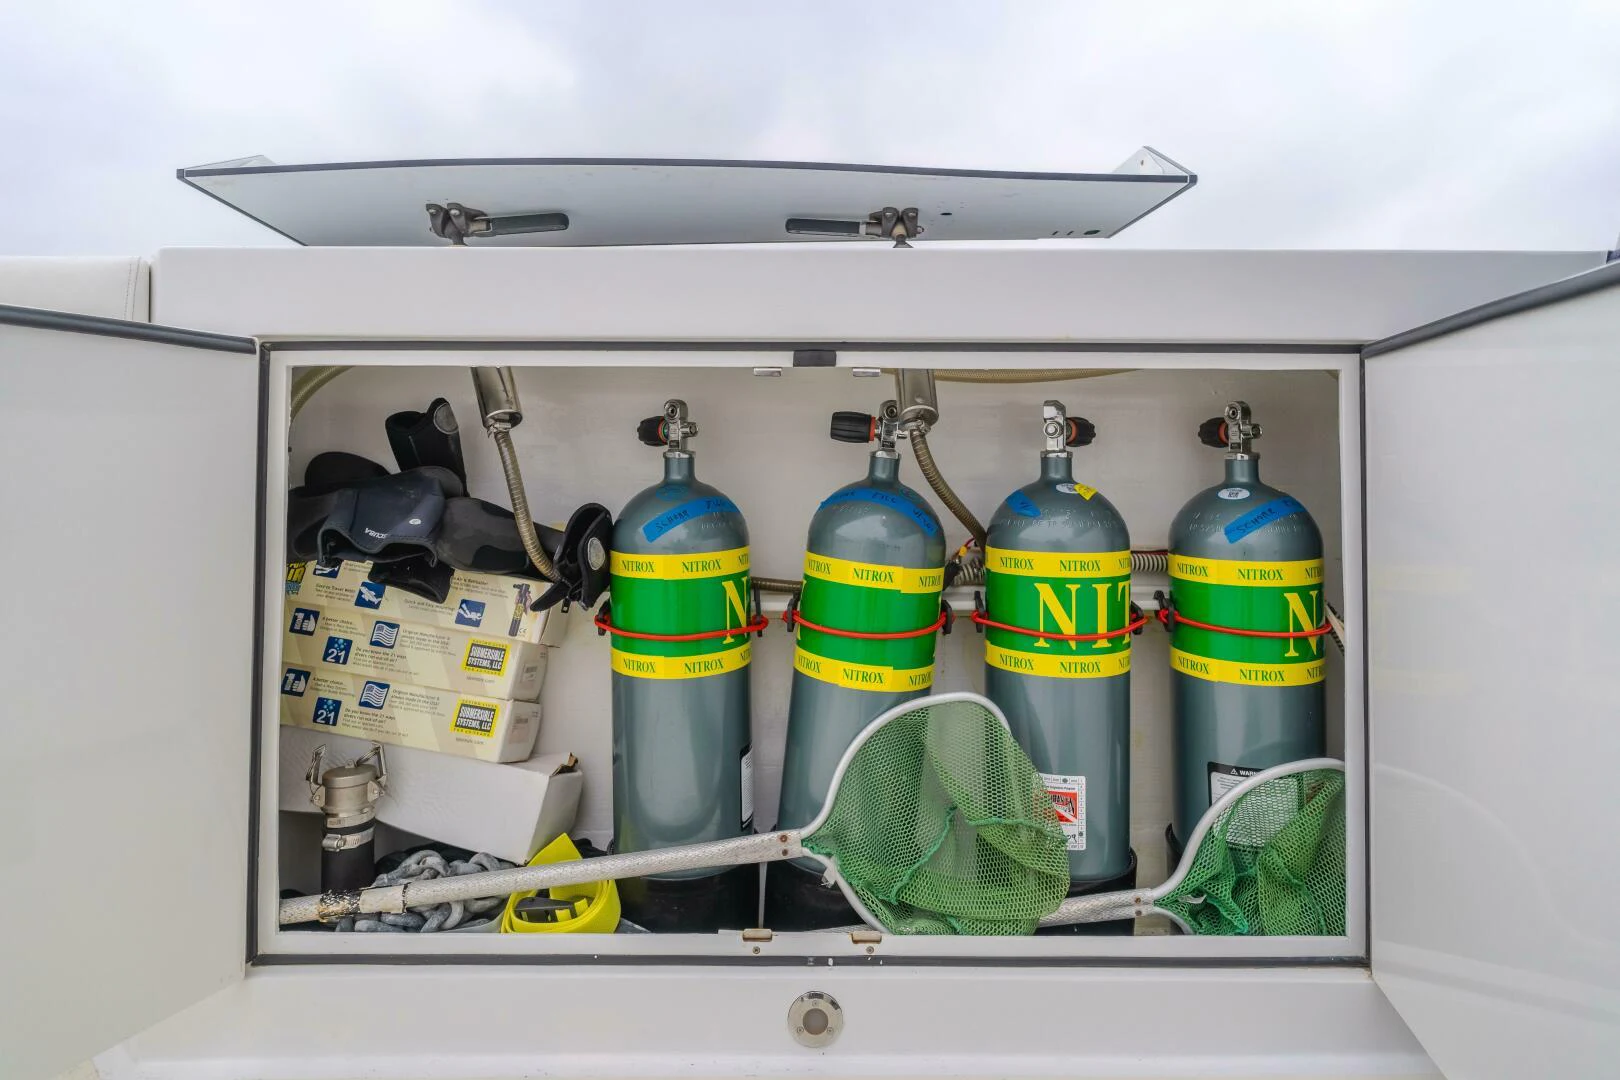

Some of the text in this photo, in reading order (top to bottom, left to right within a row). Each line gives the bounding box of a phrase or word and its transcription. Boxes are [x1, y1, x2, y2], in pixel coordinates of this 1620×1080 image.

[622, 560, 655, 573] NITROX
[682, 559, 721, 573] NITROX
[1000, 556, 1034, 570] NITROX
[1059, 559, 1101, 572] NITROX
[1177, 562, 1208, 577] NITROX
[1237, 568, 1284, 581] NITROX
[853, 567, 894, 583] NITROX
[326, 648, 346, 664] 21
[470, 646, 505, 661] SUBMERSIBLE
[492, 661, 502, 669] LLC
[623, 658, 656, 673] NITROX
[684, 658, 724, 674] NITROX
[1000, 654, 1034, 671] NITROX
[1059, 661, 1101, 673] NITROX
[1178, 656, 1209, 675] NITROX
[1239, 668, 1285, 682] NITROX
[843, 668, 884, 684] NITROX
[316, 709, 335, 725] 21
[460, 706, 494, 722] SUBMERSIBLE
[481, 721, 492, 730] LLC
